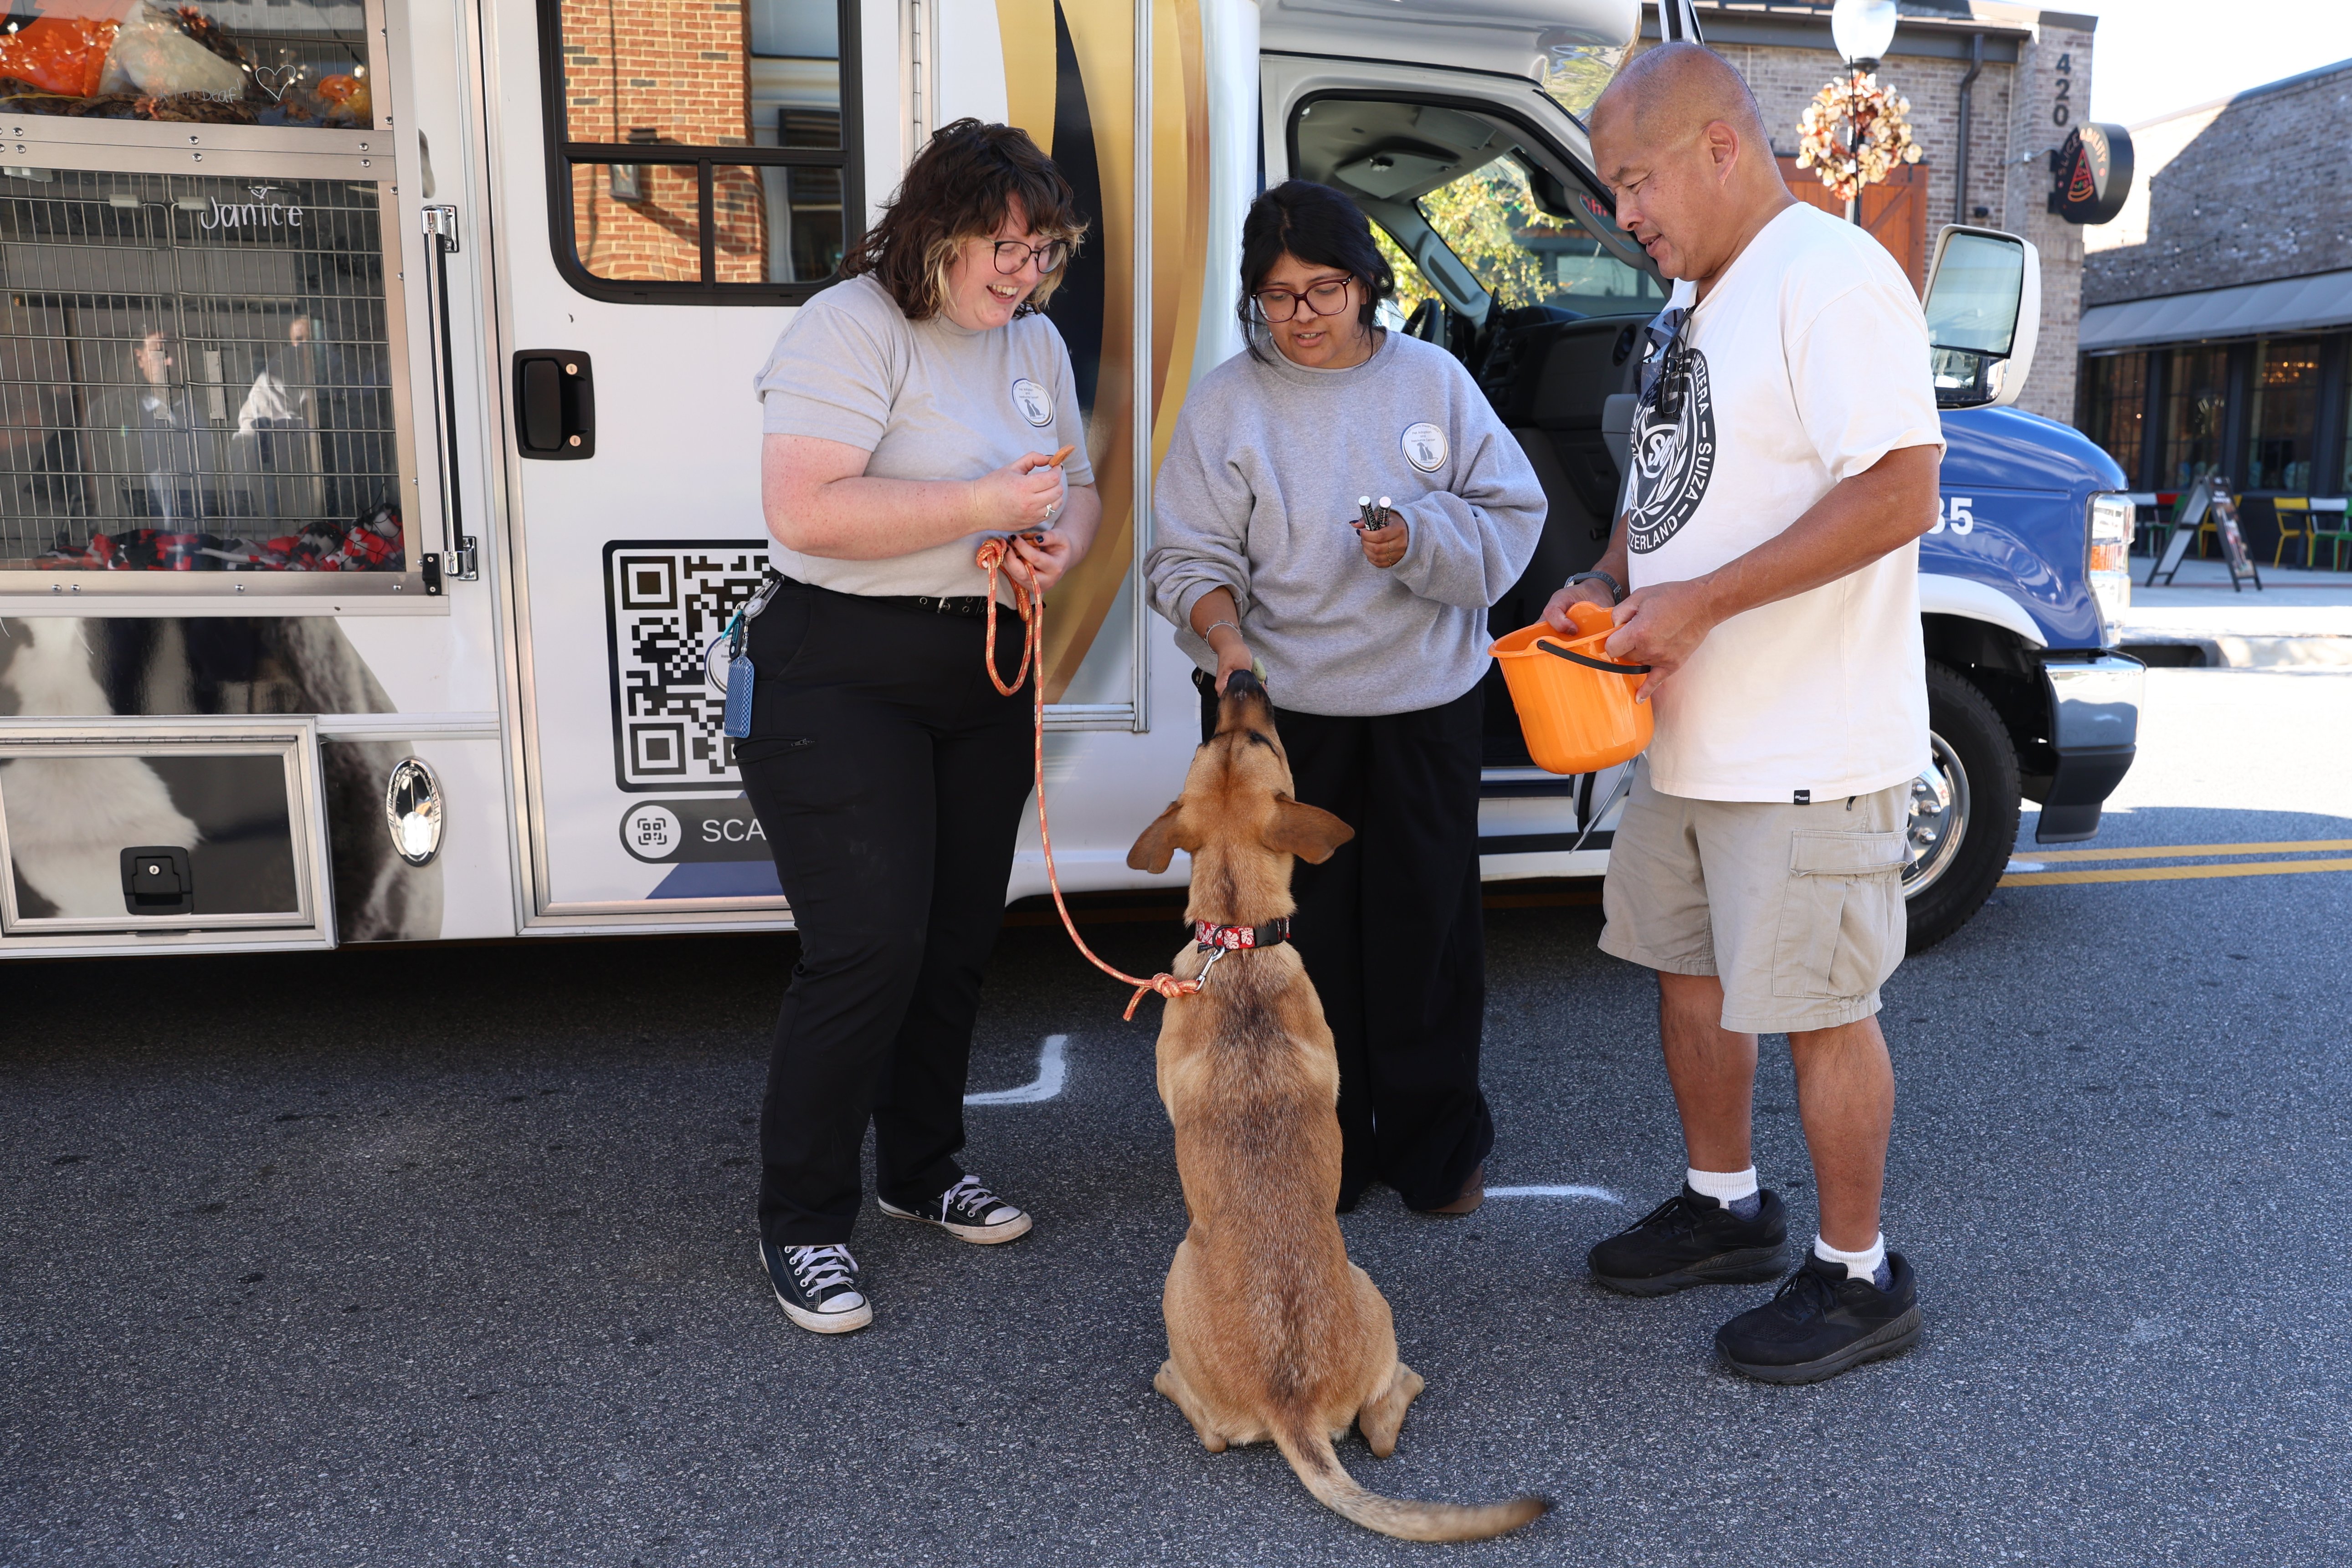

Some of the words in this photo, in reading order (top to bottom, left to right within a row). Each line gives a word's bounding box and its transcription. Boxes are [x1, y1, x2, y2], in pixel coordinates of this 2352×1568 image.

[202, 78, 242, 103] Deaf!
[2053, 53, 2071, 127] 420
[200, 188, 303, 229] Janice
[1685, 442, 1712, 500] SUIZA
[1628, 516, 1678, 550] TZERLAND
[702, 818, 767, 842] SCA
